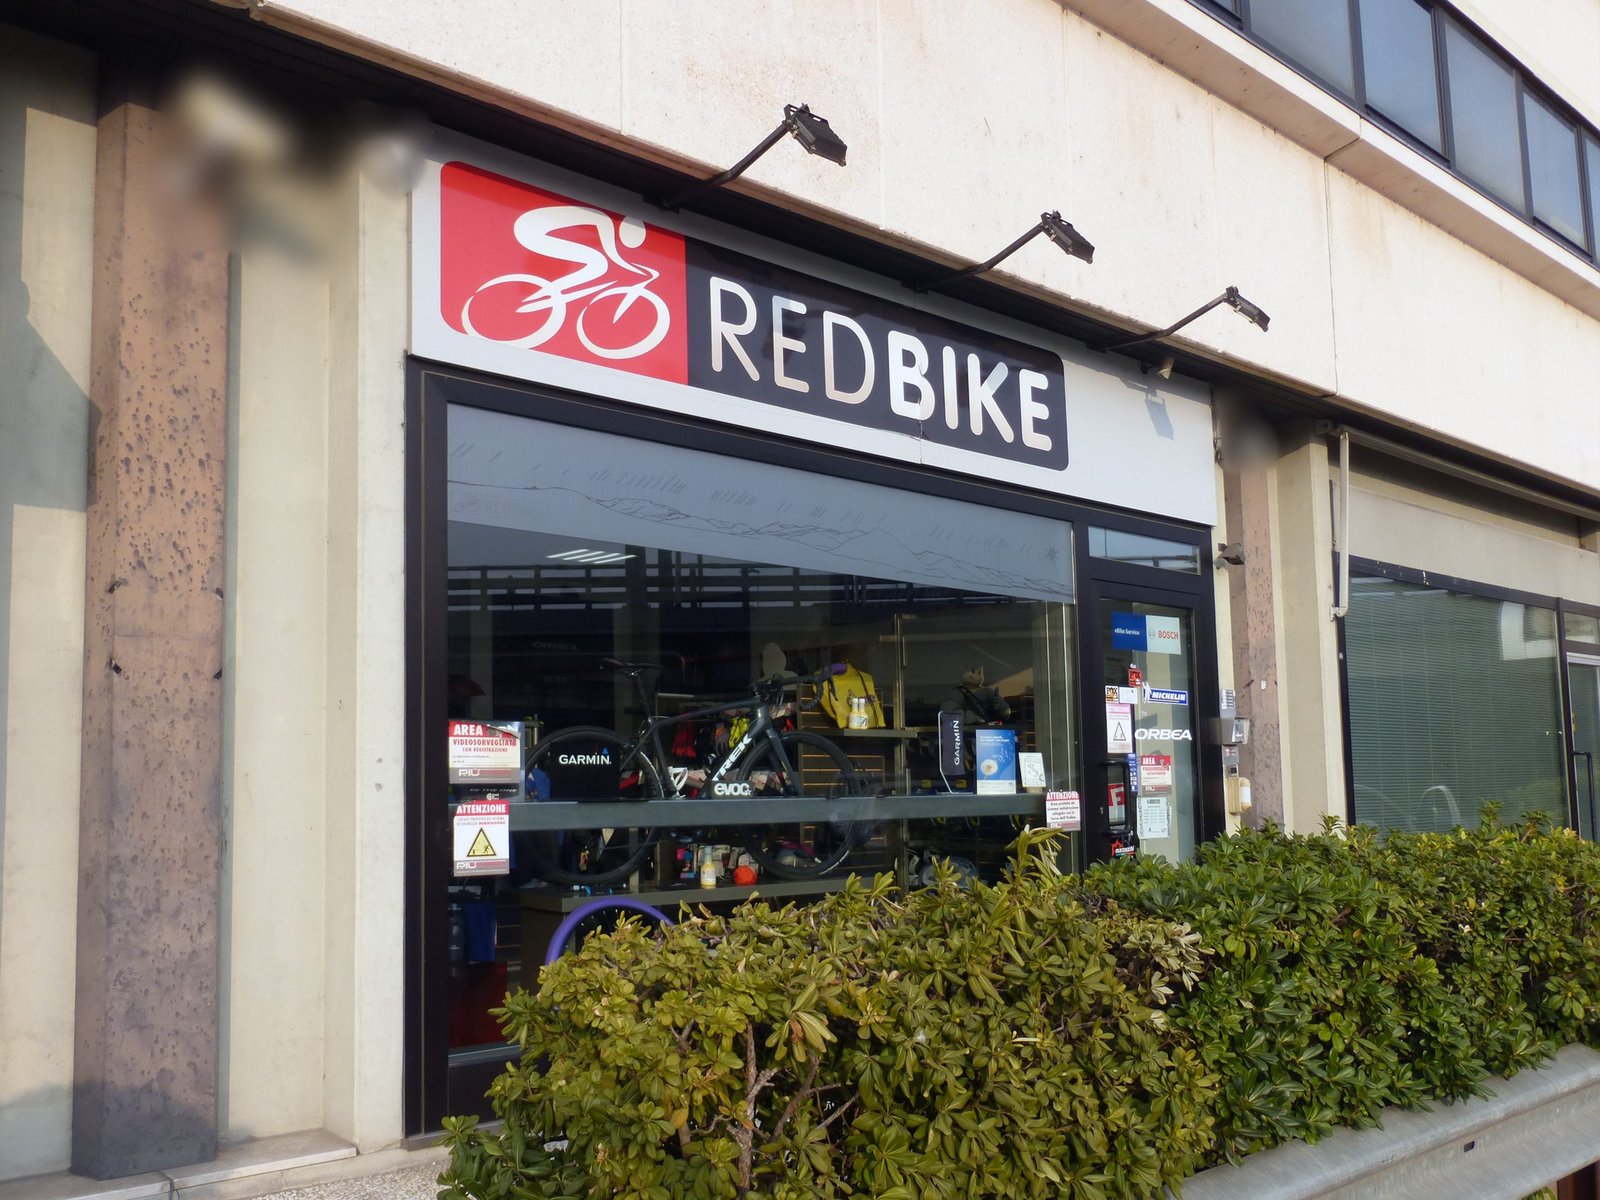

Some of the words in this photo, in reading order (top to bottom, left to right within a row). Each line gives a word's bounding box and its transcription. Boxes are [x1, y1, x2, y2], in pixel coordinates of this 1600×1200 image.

[1158, 631, 1179, 639] BOSCH
[1152, 692, 1186, 701] MICHELIN
[454, 724, 483, 736] AREA
[1134, 728, 1192, 741] ORBEA
[453, 738, 517, 747] VIDEOSORVEGLIATA
[558, 754, 610, 765] GARMIN
[712, 733, 753, 781] TREK
[1142, 757, 1155, 765] AREA
[1046, 791, 1079, 801] ATTENZIONE
[456, 803, 506, 814] ATTENZIONE
